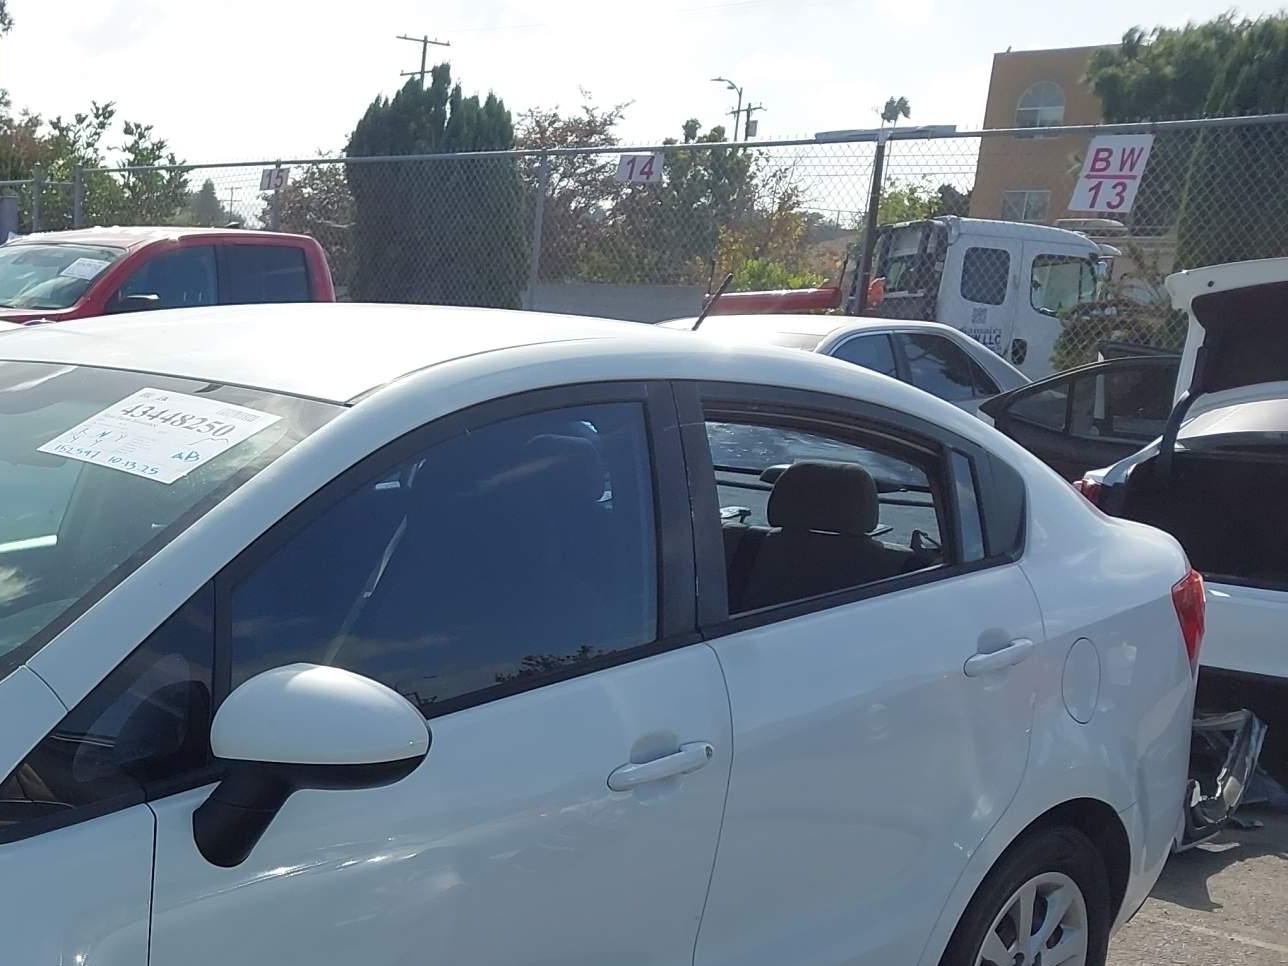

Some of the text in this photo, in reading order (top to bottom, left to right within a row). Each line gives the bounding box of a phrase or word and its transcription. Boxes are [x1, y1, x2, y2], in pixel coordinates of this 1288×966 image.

[627, 156, 655, 180] 14
[1089, 147, 1144, 173] BW
[265, 169, 283, 188] 15
[1088, 181, 1128, 210] 13
[122, 404, 236, 437] 43448250
